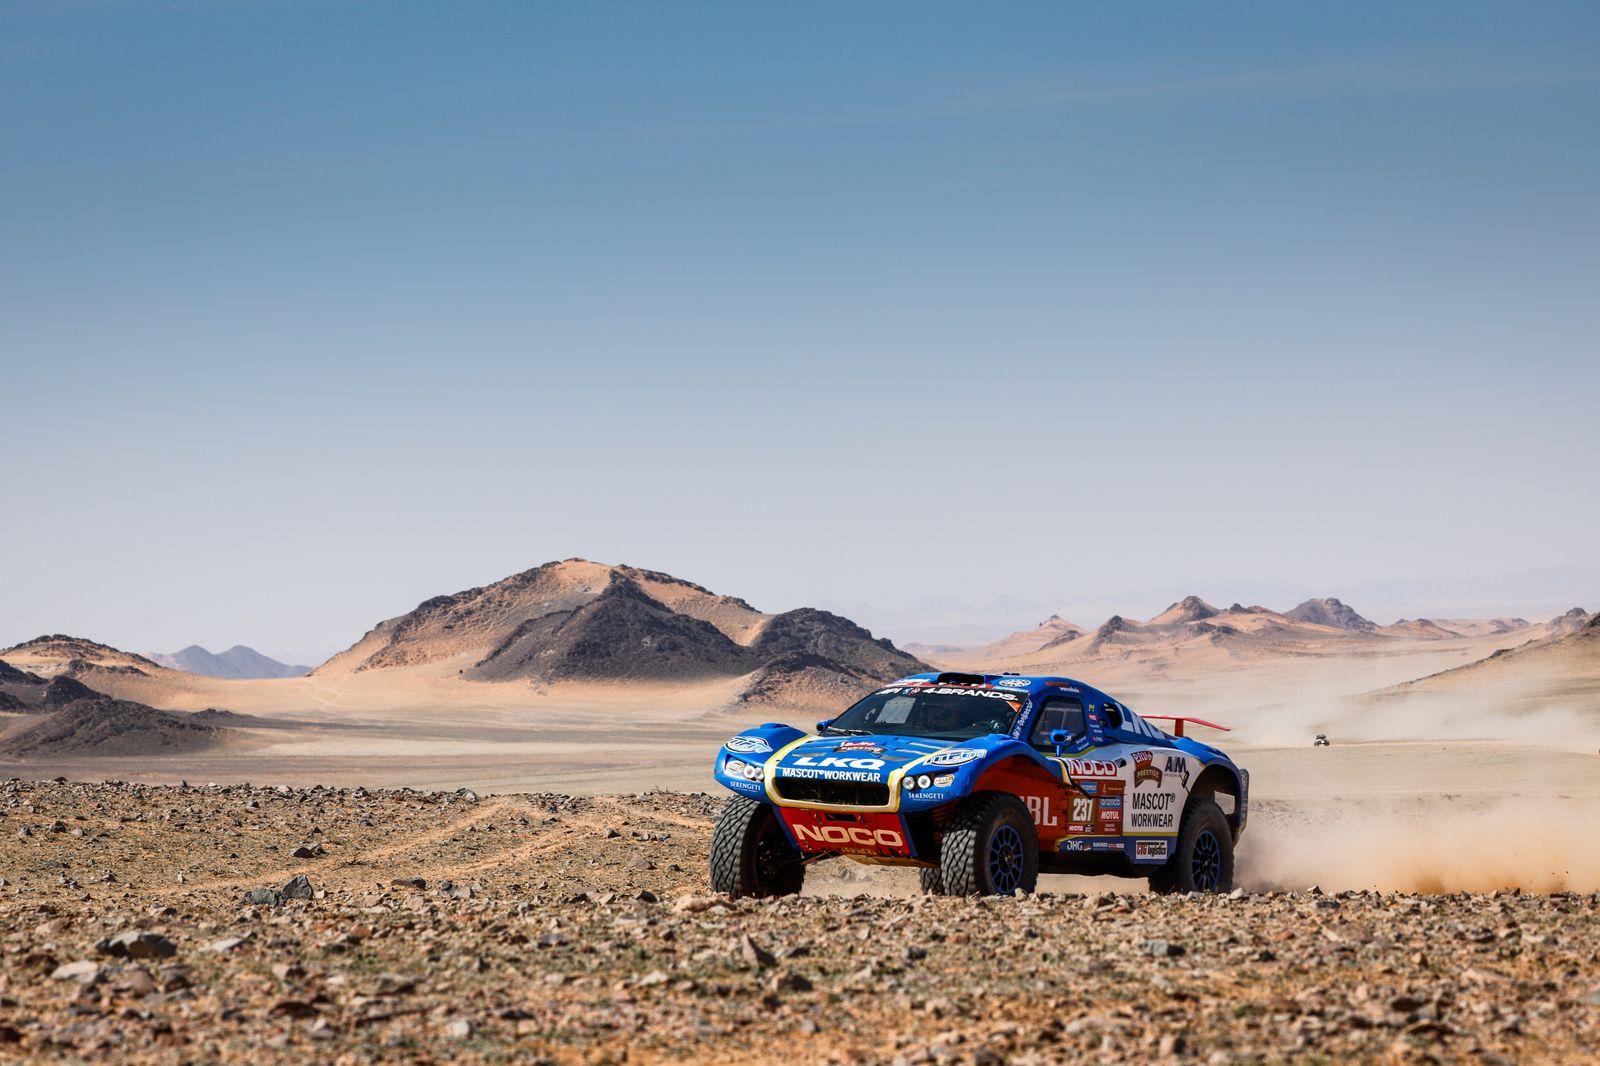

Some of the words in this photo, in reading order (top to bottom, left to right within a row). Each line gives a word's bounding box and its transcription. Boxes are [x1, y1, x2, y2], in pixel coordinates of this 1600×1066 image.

[792, 757, 886, 770] LKQ
[1070, 759, 1116, 776] NOCO
[824, 770, 880, 782] WORKWEAR
[730, 781, 761, 791] SERENGETI
[908, 792, 944, 800] SERENGETI
[1019, 796, 1058, 826] BL
[1072, 798, 1094, 822] 237
[1100, 810, 1120, 820] MOTUL
[1131, 813, 1174, 828] WORKWEAR
[792, 823, 904, 847] NOCO
[1147, 844, 1167, 857] logistics
